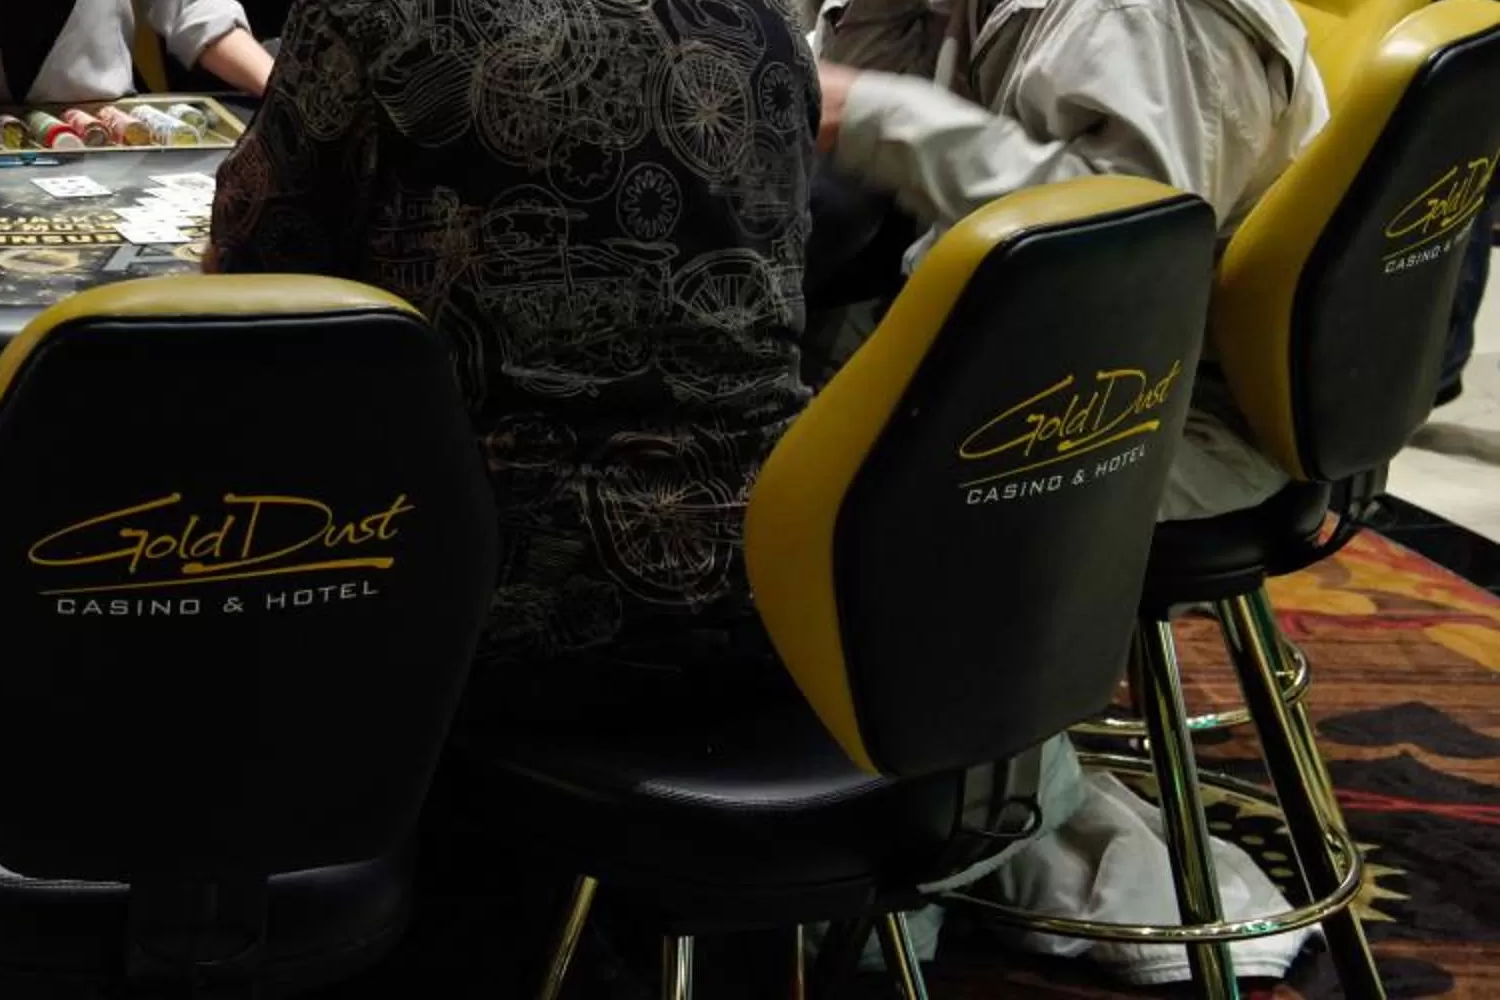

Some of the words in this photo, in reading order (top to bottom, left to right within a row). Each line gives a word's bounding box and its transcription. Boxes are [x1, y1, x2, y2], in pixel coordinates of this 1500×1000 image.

[959, 374, 1099, 459] Gold
[1057, 359, 1182, 453] Dust
[966, 475, 1064, 505] CASINO
[1071, 468, 1086, 486] &
[1094, 444, 1146, 478] HOTEL
[27, 491, 236, 575] Gold
[181, 492, 417, 575] Dust
[56, 598, 201, 616] CASINO
[222, 597, 244, 614] &
[265, 579, 380, 611] HOTEL
